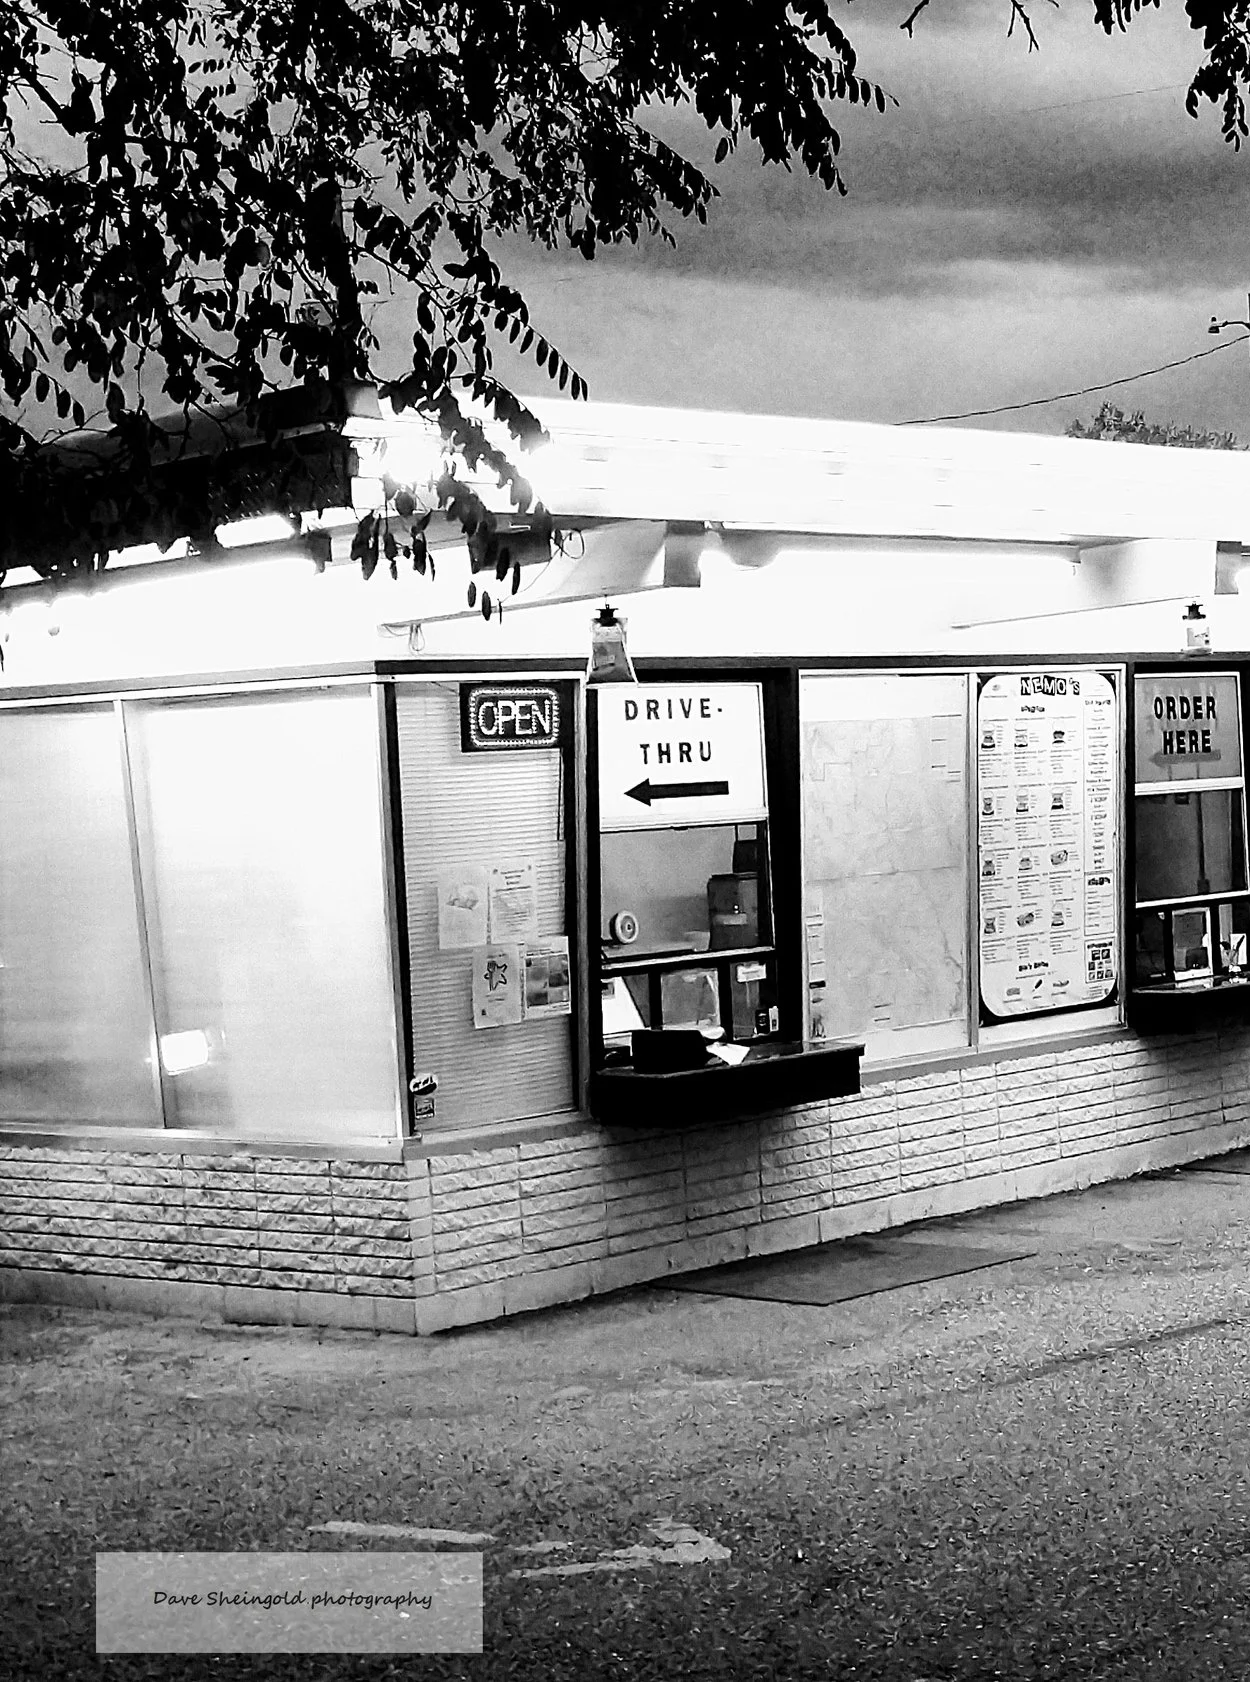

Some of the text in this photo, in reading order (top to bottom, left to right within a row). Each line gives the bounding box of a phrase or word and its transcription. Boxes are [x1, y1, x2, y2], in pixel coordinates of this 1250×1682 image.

[478, 699, 551, 735] OPEN
[624, 698, 723, 721] DRIVE-
[1153, 695, 1216, 720] ORDER
[639, 741, 711, 765] THRU
[1163, 729, 1211, 755] HERE
